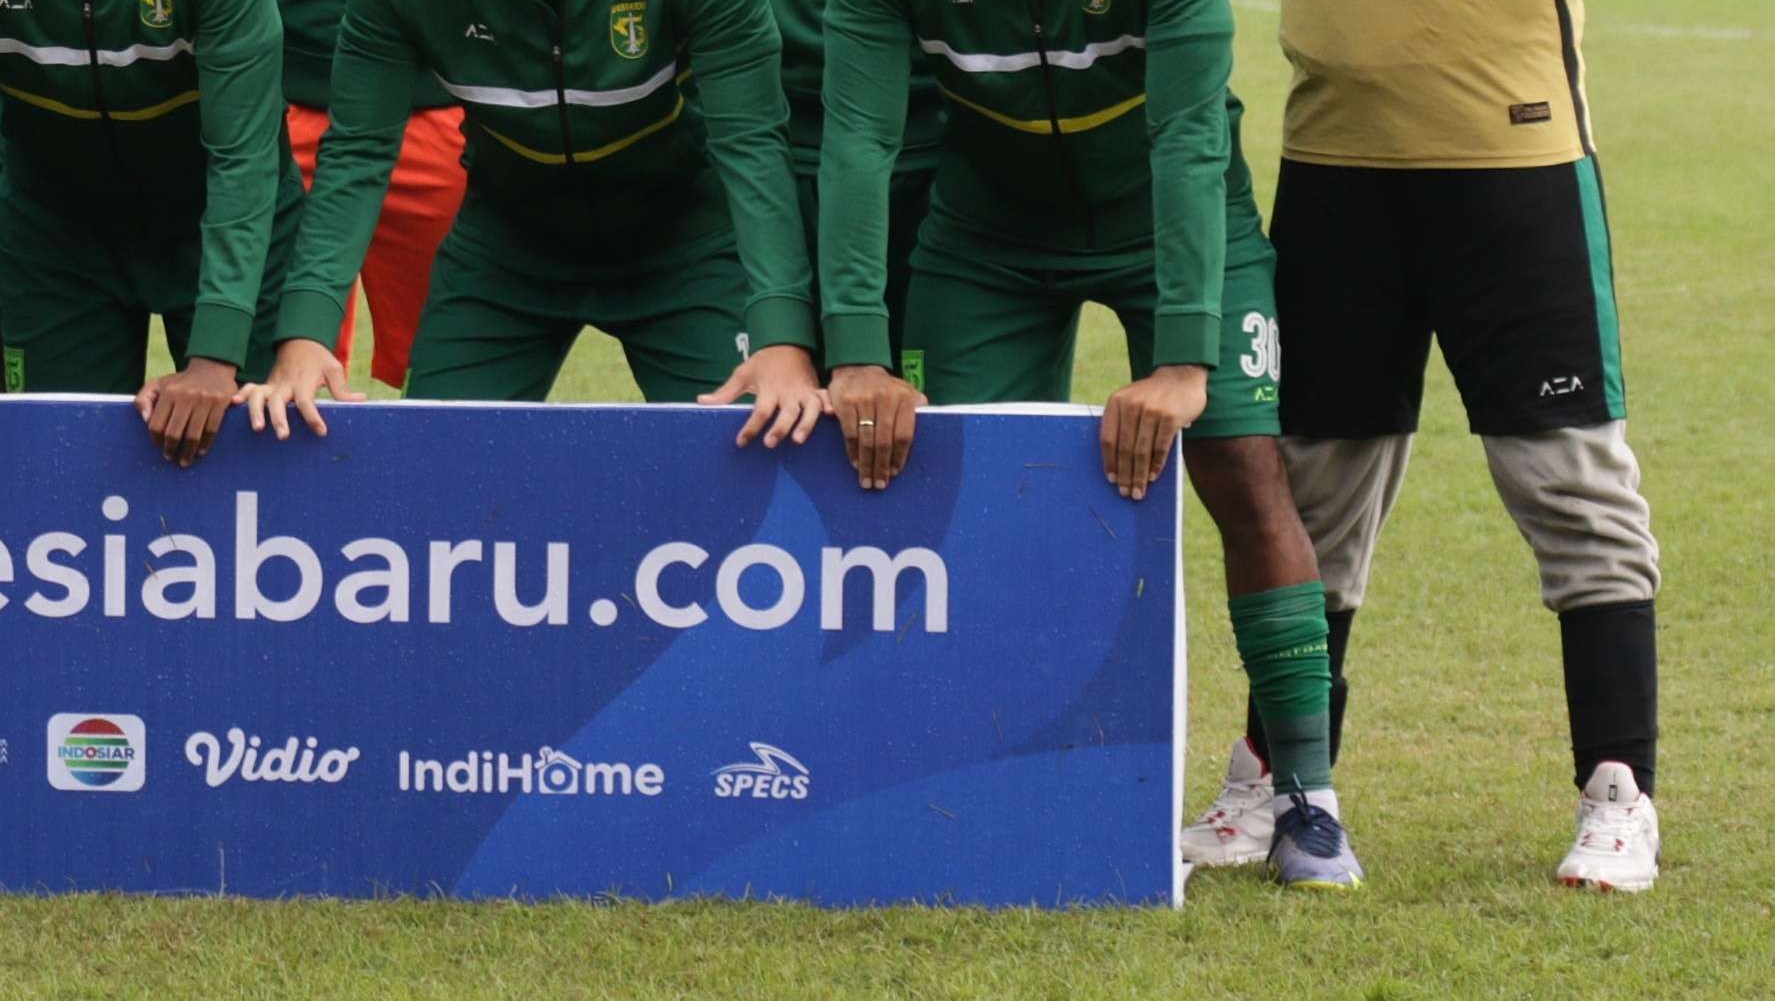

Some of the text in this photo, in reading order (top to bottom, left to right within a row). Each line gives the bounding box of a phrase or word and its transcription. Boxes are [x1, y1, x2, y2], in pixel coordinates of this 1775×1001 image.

[1240, 311, 1281, 382] 30
[57, 746, 136, 761] INDOSIAR
[185, 727, 361, 787] Vidio
[398, 746, 665, 796] IndiHome
[713, 773, 810, 800] SPECS
